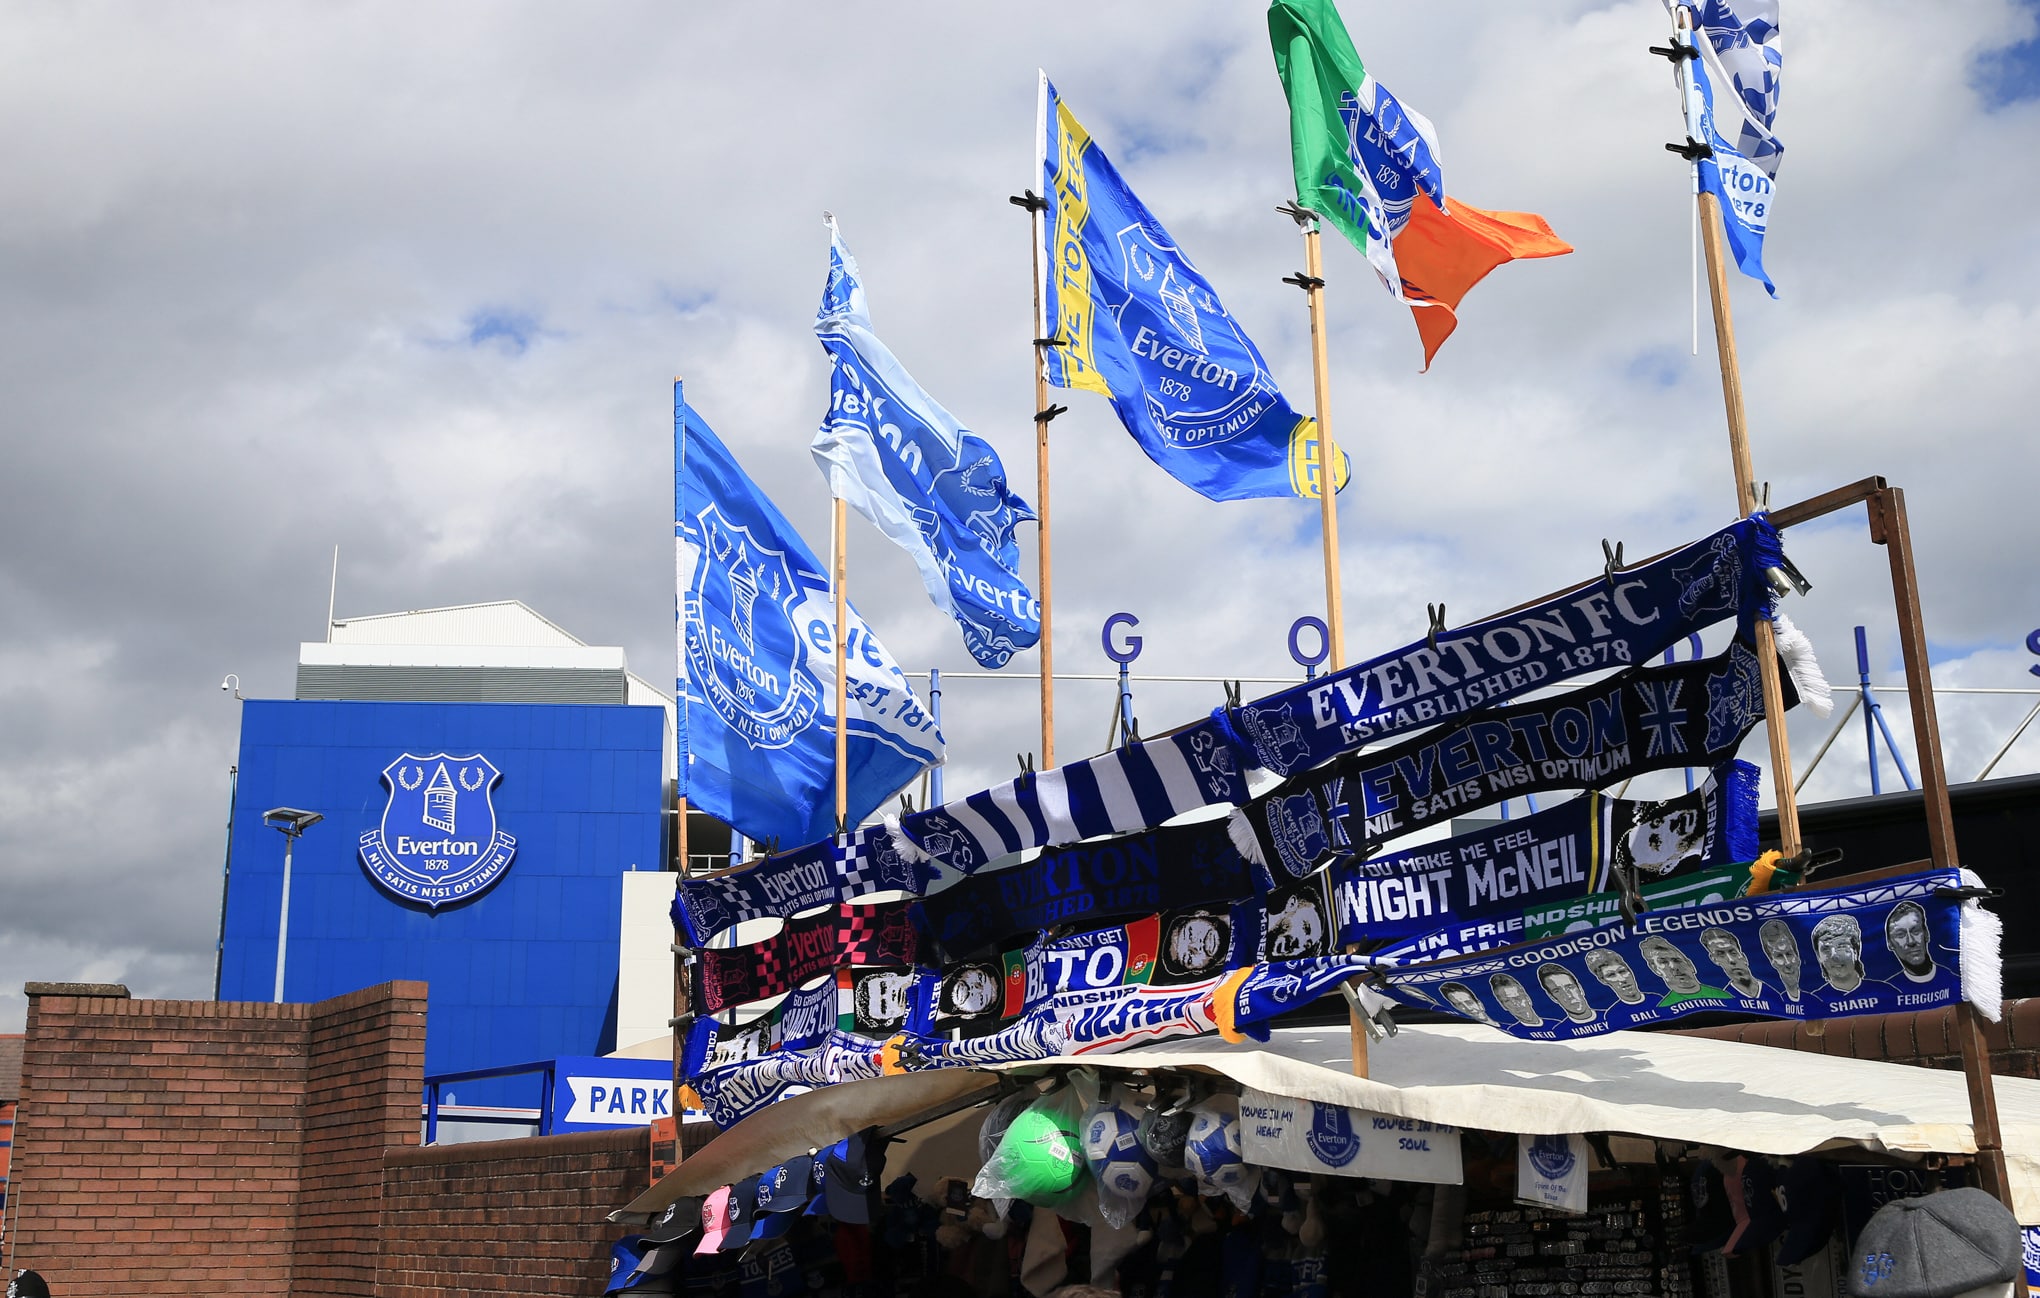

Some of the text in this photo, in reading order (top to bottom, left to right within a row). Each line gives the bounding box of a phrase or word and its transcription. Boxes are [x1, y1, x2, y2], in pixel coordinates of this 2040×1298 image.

[1375, 164, 1400, 190] 1878
[1722, 164, 1770, 194] rton
[1131, 326, 1238, 392] Everton
[1160, 377, 1192, 402] 1878
[1185, 401, 1263, 442] OPTIMUM
[946, 547, 1041, 622] Everto
[711, 624, 779, 696] Everton
[1308, 579, 1661, 731] EVERTON FC
[689, 635, 705, 671] NIL
[706, 674, 737, 720] SATIS
[738, 715, 766, 741] NISI
[1340, 660, 1548, 745] ESTABLISHED
[1556, 639, 1632, 673] 1878
[1359, 687, 1629, 820] EVERTON
[1364, 745, 1632, 840] NIL SATIS NISI OPTIMUM
[1283, 807, 1308, 857] Everton
[1701, 788, 1718, 862] McNEIL
[396, 836, 479, 857] Everton
[1398, 850, 1454, 874] MAKE
[1460, 841, 1489, 863] ME
[1493, 829, 1539, 853] FEEL
[368, 852, 506, 897] NIL SATIS NISI OPTIMUM
[423, 859, 449, 871] 1878
[755, 858, 830, 904] Everton
[1465, 833, 1585, 907] McNEIL
[780, 901, 800, 918] SATIS
[800, 893, 814, 908] NISI
[1097, 928, 1123, 946] GET
[1418, 933, 1449, 953] IN
[1460, 897, 1620, 942] FRIENDSHI
[1509, 923, 1627, 969] GOODISON
[1632, 906, 1754, 936] LEGENDS
[1025, 945, 1124, 1003] BETO
[927, 980, 943, 1021] BETO
[1669, 997, 1728, 1015] SOUTHALL
[1739, 998, 1770, 1012] DEAN
[1829, 996, 1880, 1014] SHARP
[1896, 988, 1951, 1007] FERGUSON
[1571, 1021, 1611, 1037] HARVEY
[1630, 1009, 1661, 1023] BALL
[590, 1085, 669, 1116] PARK
[1240, 1105, 1294, 1124] YOU'RE IN MY
[1255, 1124, 1283, 1139] HEART
[1318, 1131, 1347, 1145] Everton
[1372, 1116, 1414, 1132] YOU'RE
[1398, 1137, 1431, 1152] SOUL
[742, 1246, 795, 1278] TOEES
